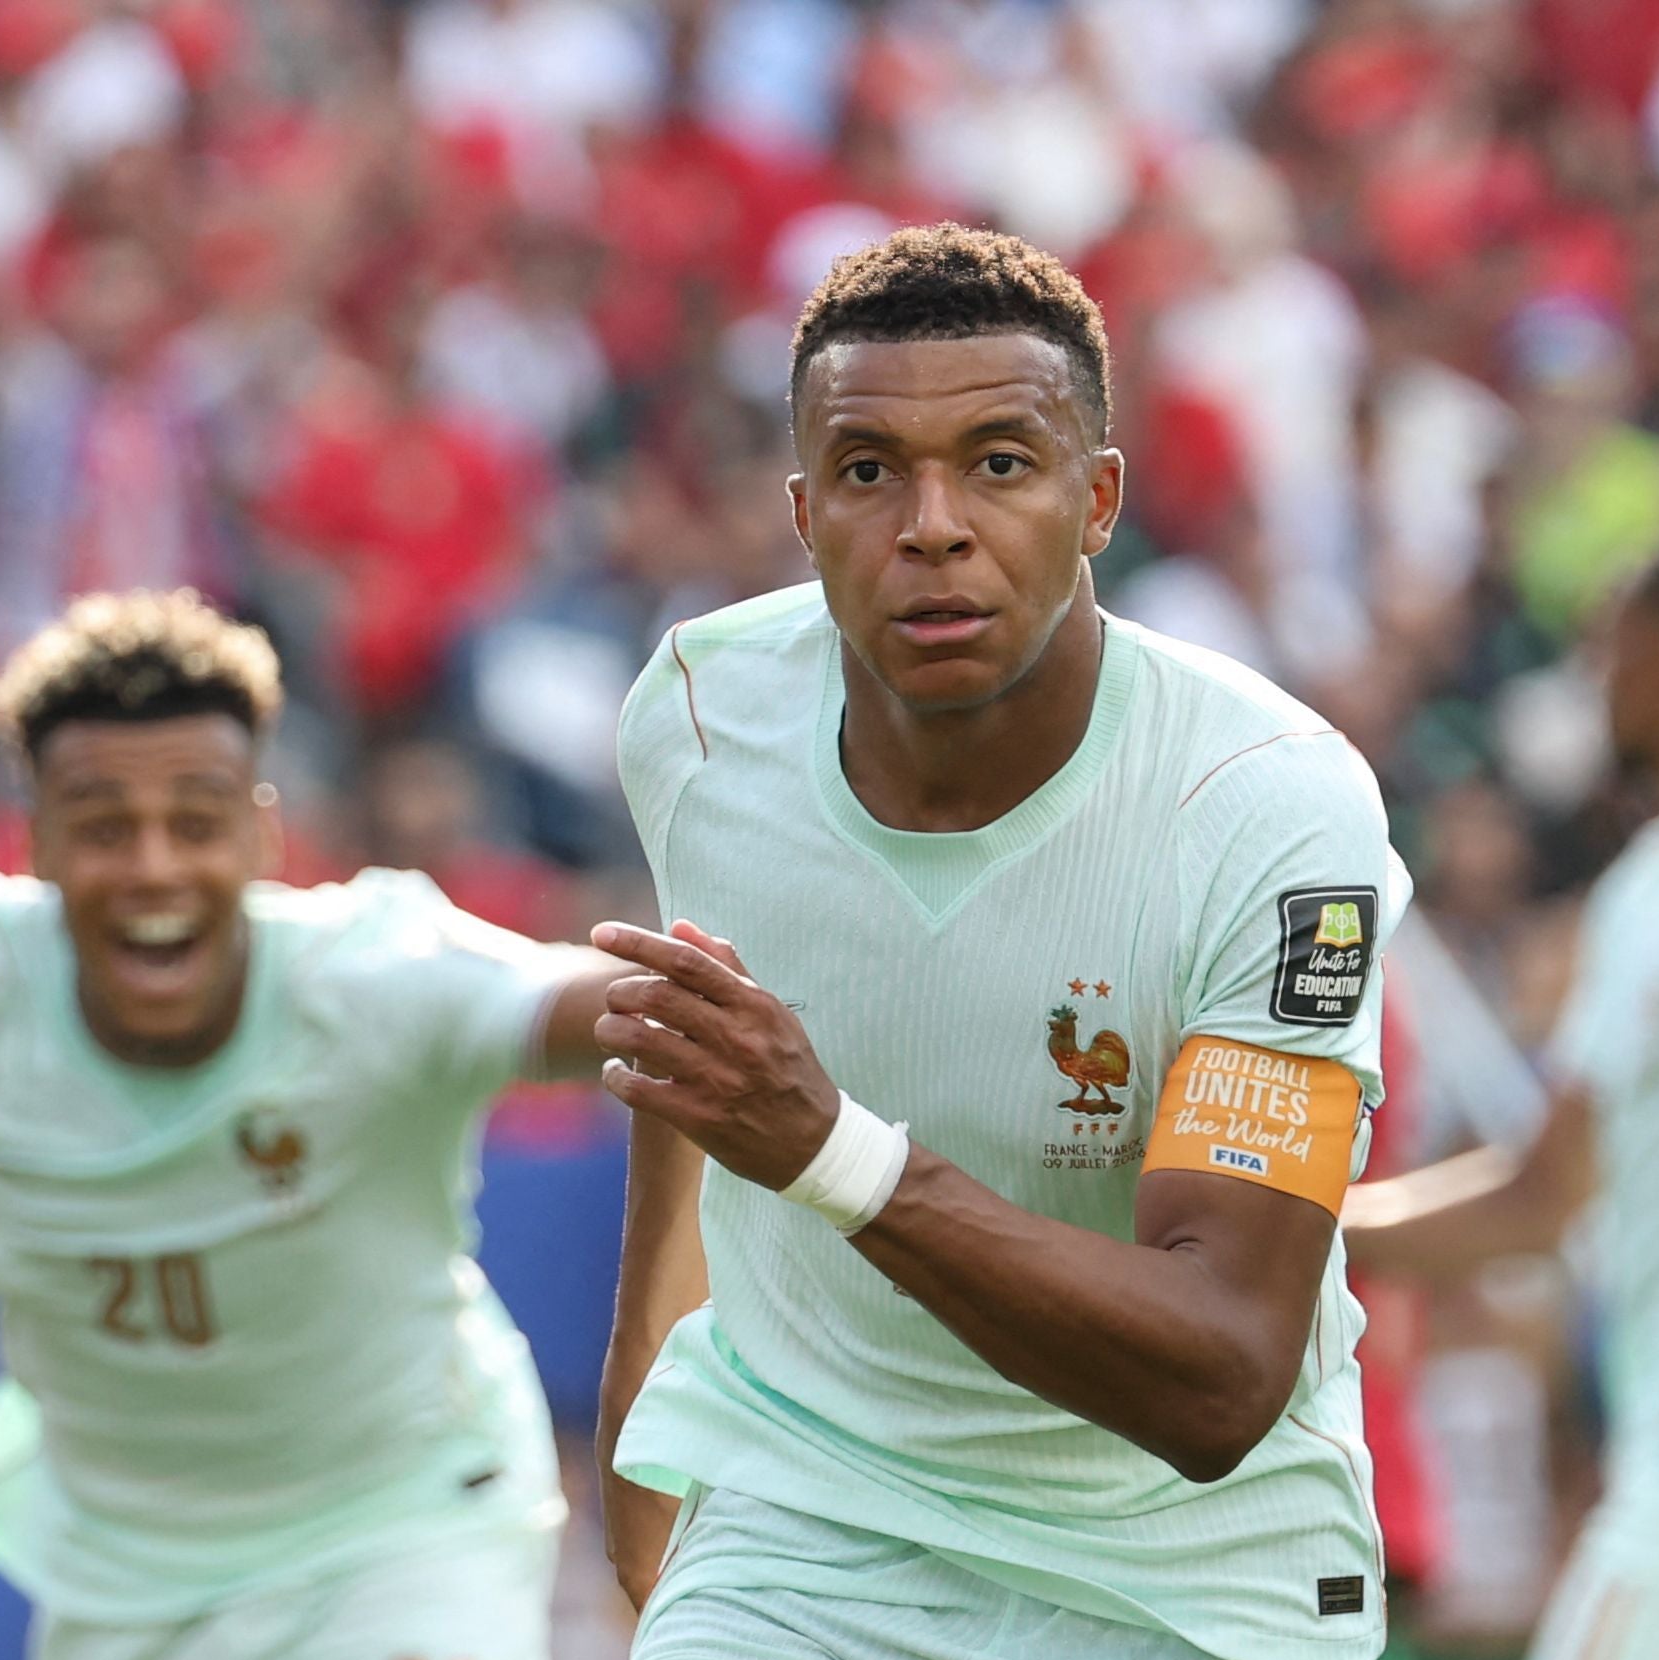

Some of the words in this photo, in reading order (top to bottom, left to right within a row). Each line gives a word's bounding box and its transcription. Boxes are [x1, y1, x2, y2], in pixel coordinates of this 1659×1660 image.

[1308, 947, 1346, 973] Unite
[1294, 974, 1362, 997] EDUCATION
[1316, 999, 1343, 1012] FIFA
[1192, 1047, 1311, 1092] FOOTBALL
[1184, 1071, 1309, 1126] UNITES
[1044, 1143, 1088, 1156] FRANCE
[1102, 1136, 1144, 1157] MAROC
[1173, 1106, 1220, 1135] the
[1226, 1113, 1312, 1163] World
[1043, 1158, 1062, 1169] 09
[1068, 1158, 1106, 1169] JUILLET
[1215, 1149, 1263, 1172] FIFA
[84, 1252, 214, 1347] 20
